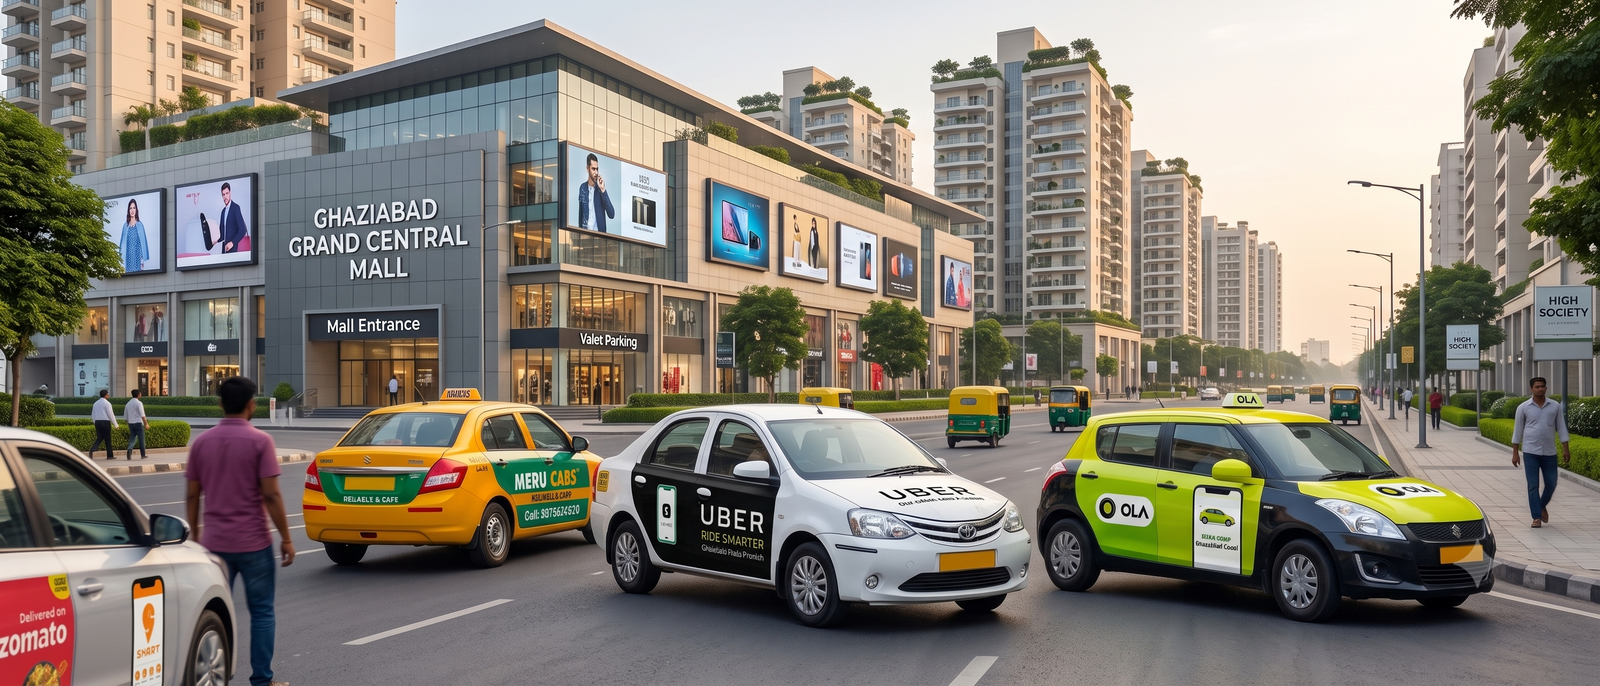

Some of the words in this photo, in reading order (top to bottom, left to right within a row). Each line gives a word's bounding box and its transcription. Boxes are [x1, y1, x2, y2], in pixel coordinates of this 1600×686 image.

[314, 198, 438, 229] GHAZIABAD
[289, 232, 361, 257] GRAND
[366, 224, 470, 252] CENTRAL
[350, 256, 409, 281] MALL
[1549, 295, 1578, 306] HIGH
[1539, 307, 1589, 318] SOCIETY
[327, 318, 354, 333] Mall
[358, 318, 421, 333] Entrance
[579, 332, 604, 346] Valet
[604, 334, 638, 350] Parking
[1236, 395, 1258, 404] OLA
[514, 471, 547, 491] MERU
[550, 468, 577, 487] CABS
[878, 486, 976, 500] UBER
[1402, 485, 1440, 495] OLA
[700, 503, 764, 534] UBER
[1120, 503, 1150, 520] OLA
[701, 530, 721, 543] RIDE
[722, 533, 764, 550] SMARTER
[19, 608, 55, 624] Delivered
[56, 607, 66, 617] on
[0, 622, 67, 659] zomato
